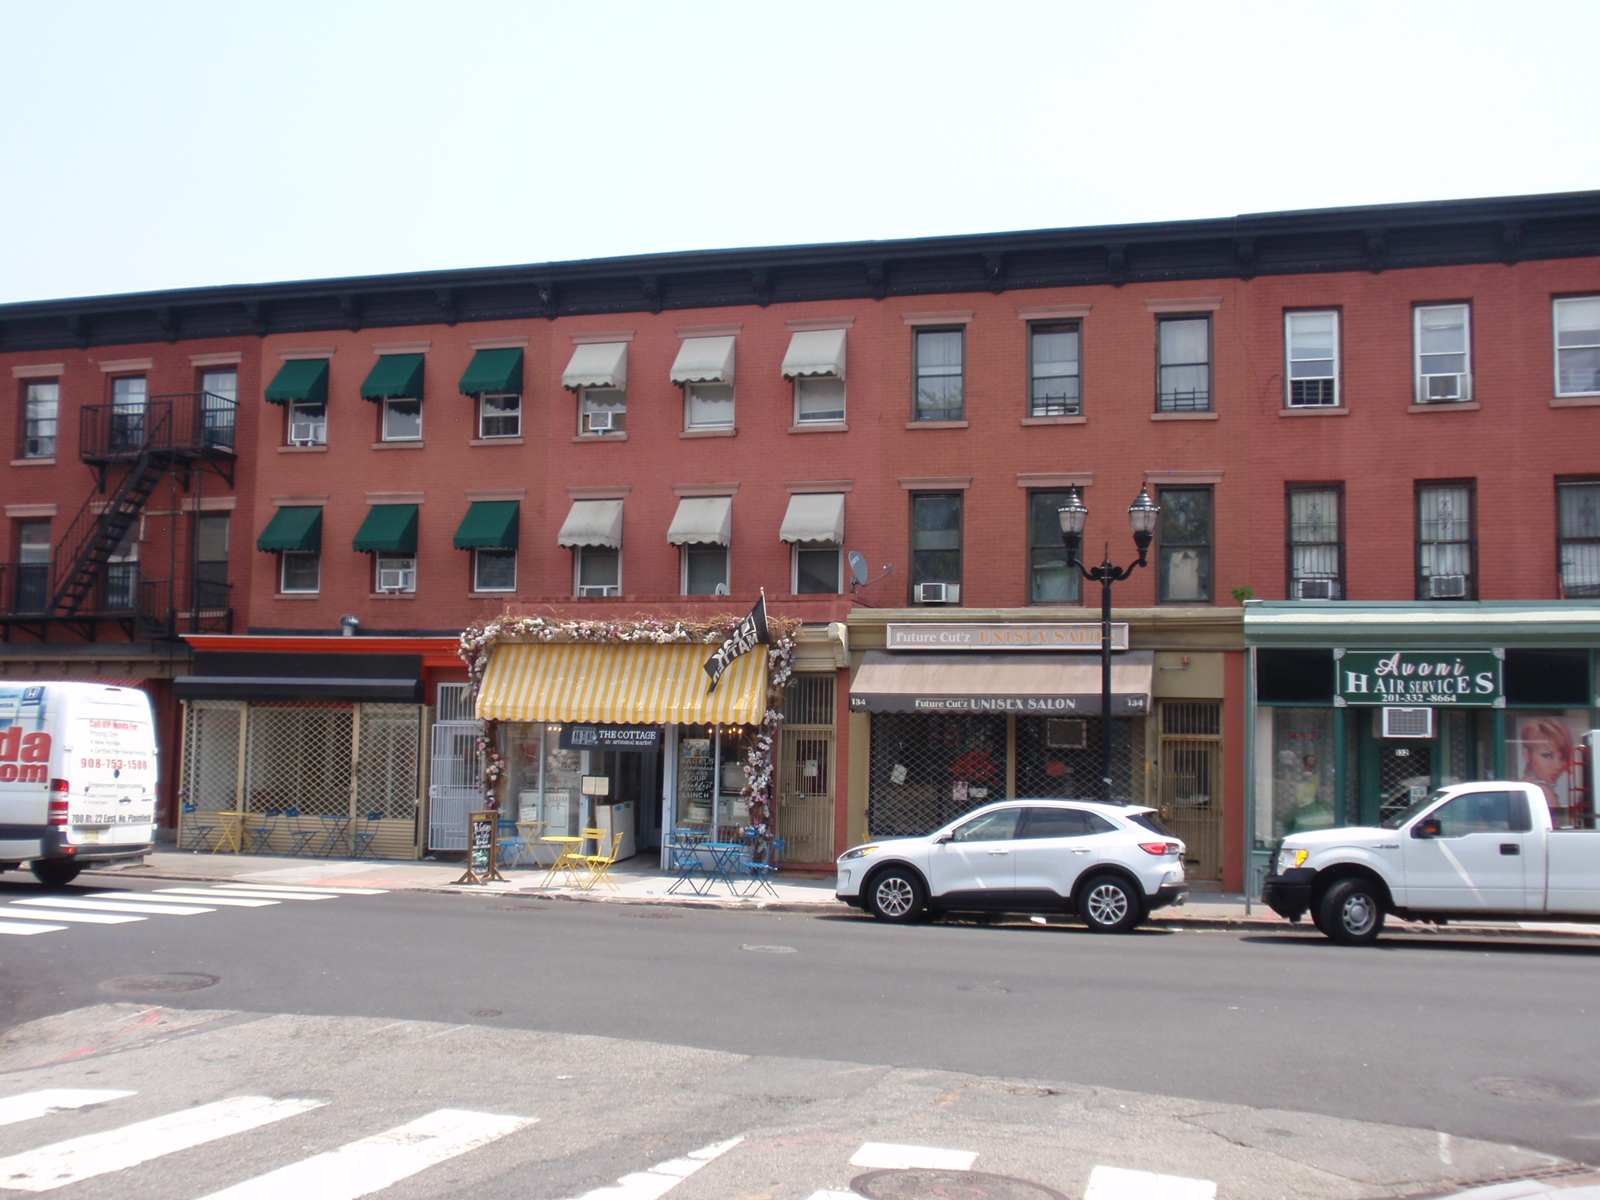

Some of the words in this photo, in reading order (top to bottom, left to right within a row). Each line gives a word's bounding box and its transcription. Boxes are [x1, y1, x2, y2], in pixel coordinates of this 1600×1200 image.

[896, 632, 937, 643] Future
[940, 632, 971, 643] Cut'z
[979, 630, 1048, 644] UNISEX
[1374, 652, 1466, 676] Avoni
[1409, 672, 1495, 694] SERVICES
[851, 698, 866, 706] 134
[915, 699, 944, 709] Future
[970, 698, 1024, 709] UNISEX
[1027, 698, 1076, 709] SALON
[1127, 698, 1144, 707] 134
[599, 730, 617, 738] THE
[617, 730, 656, 739] COTTAGE
[80, 758, 147, 770] 908-753-1500
[71, 814, 84, 823] 700
[95, 814, 103, 823] 22
